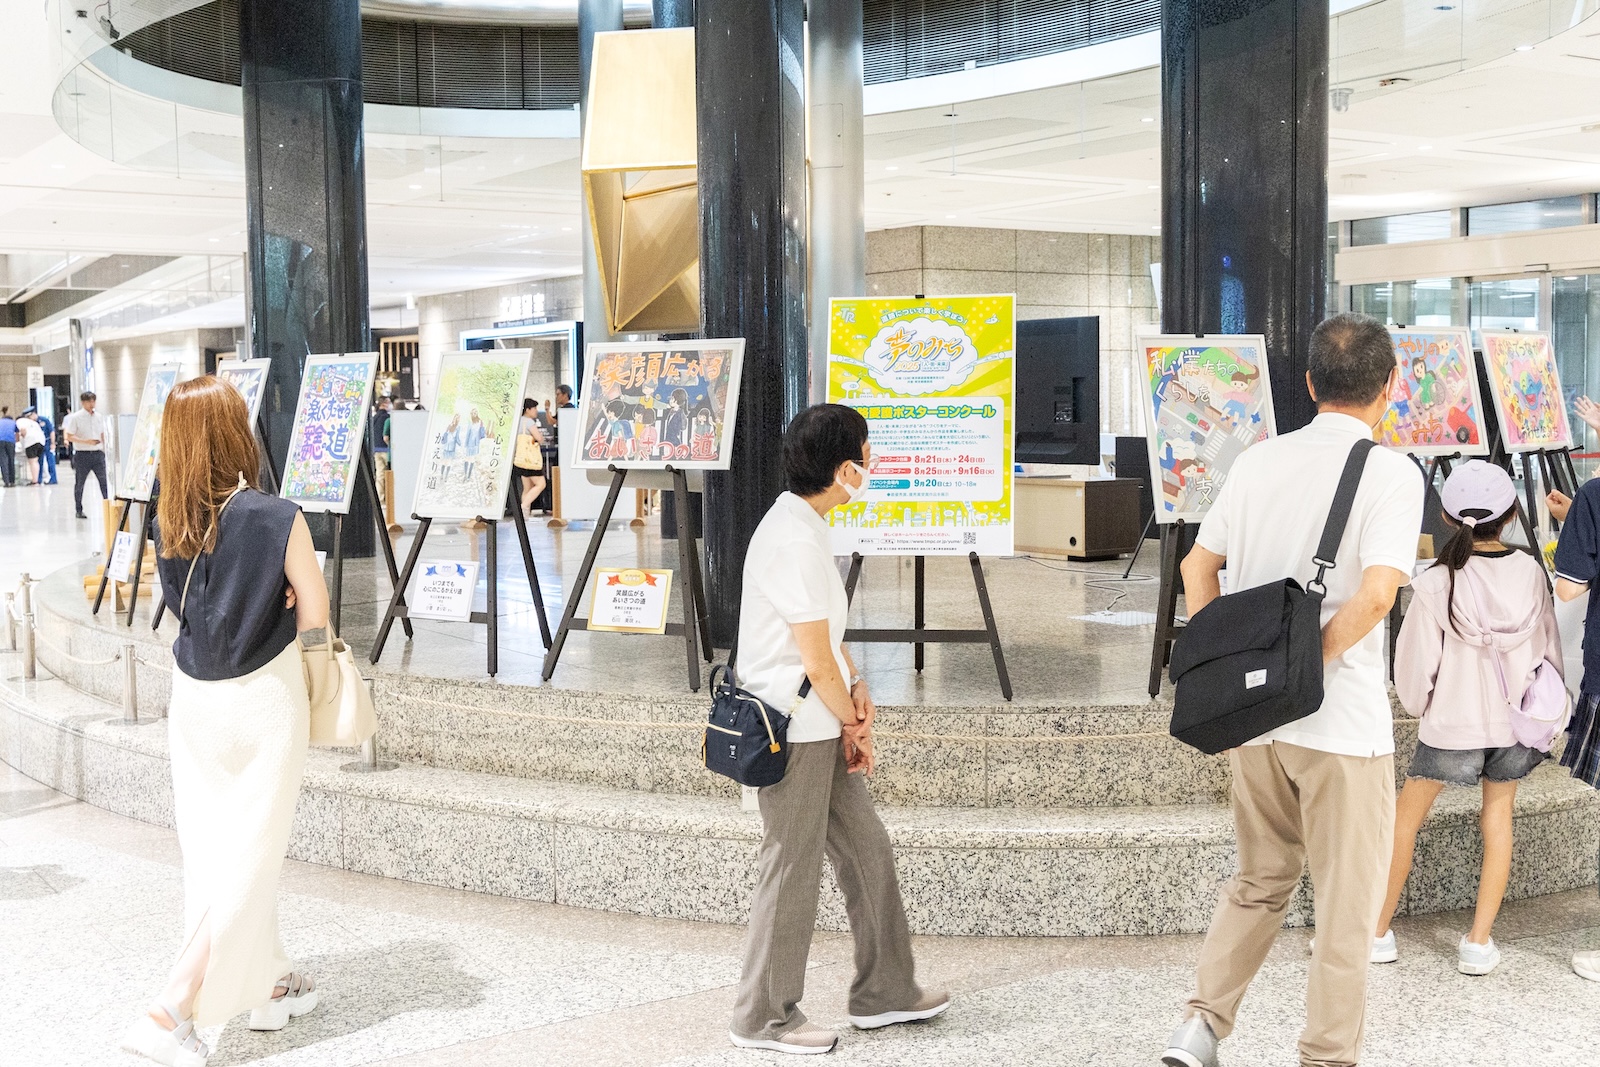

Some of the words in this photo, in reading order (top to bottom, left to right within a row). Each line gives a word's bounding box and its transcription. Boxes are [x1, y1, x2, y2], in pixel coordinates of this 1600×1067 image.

[880, 328, 964, 371] 夢のみち
[1392, 336, 1440, 360] やりの
[596, 353, 723, 391] 笑顔広がる
[894, 361, 920, 371] 2025
[1155, 380, 1210, 402] くらしを
[853, 405, 997, 420] 路愛護ポスターコンクール
[1412, 412, 1443, 444] みち
[589, 430, 719, 460] あいさつの道
[612, 597, 646, 605] あいさつの道
[615, 589, 645, 597] 笑顔広がる
